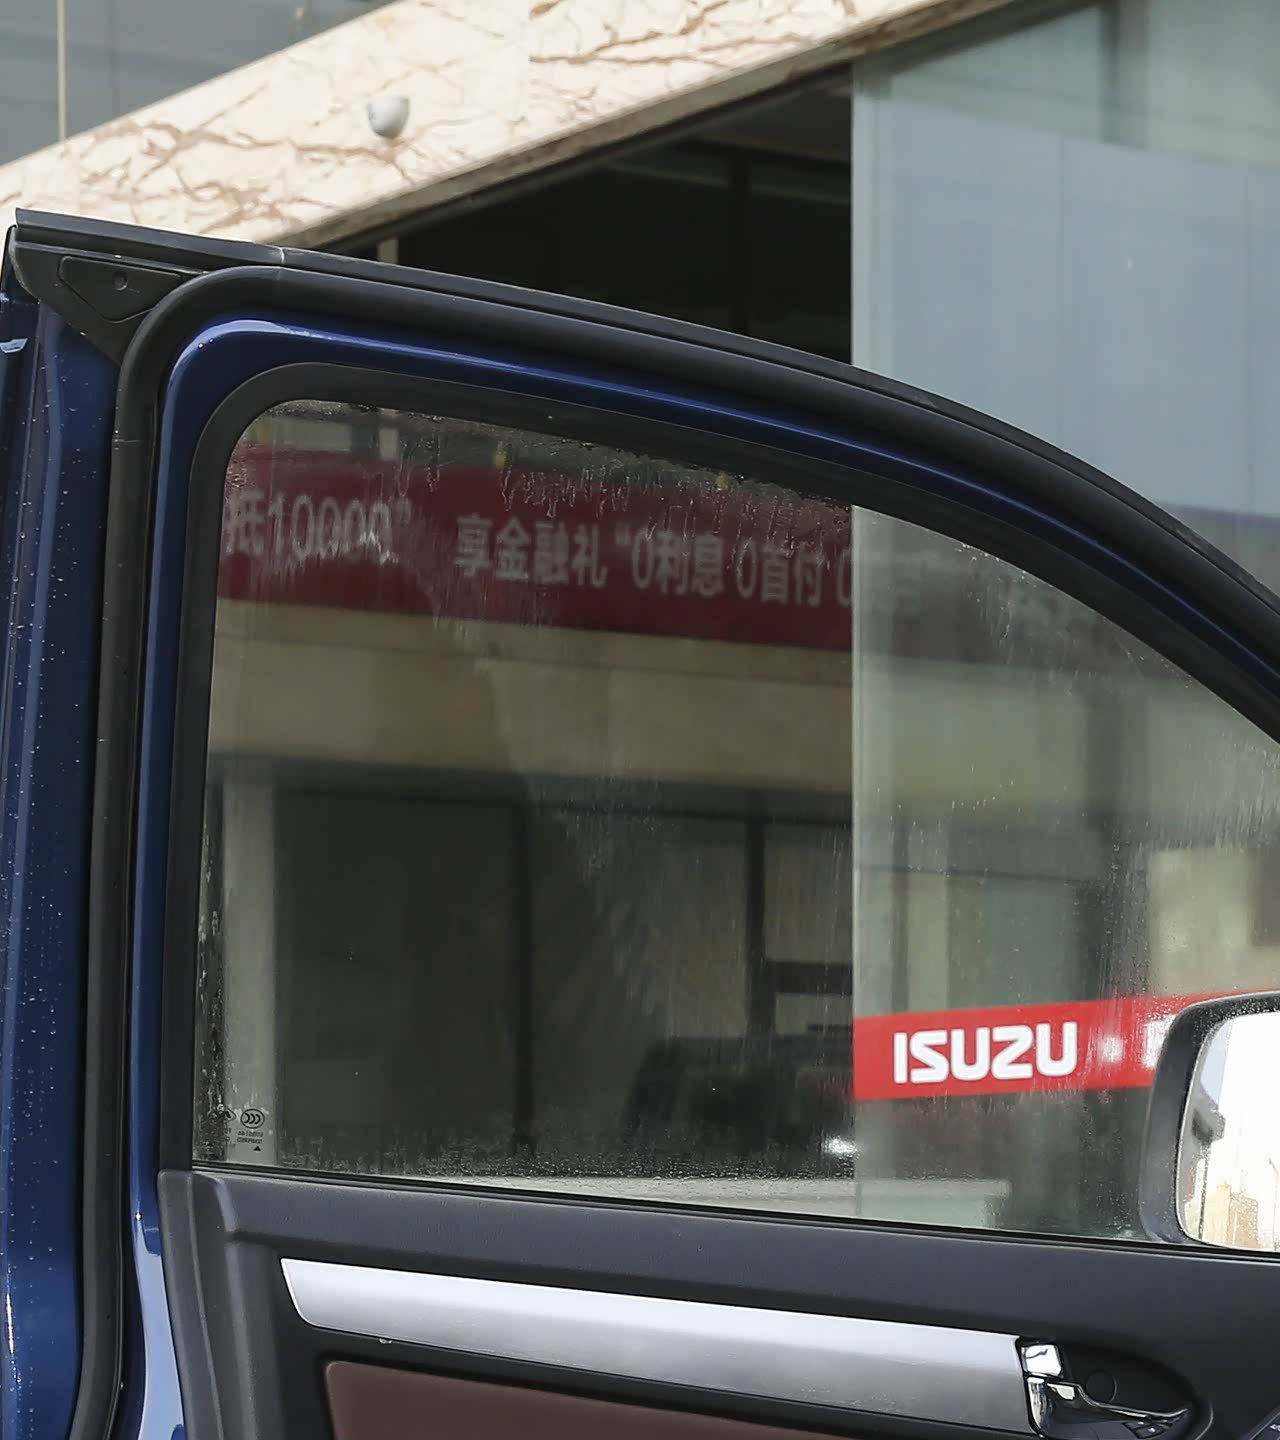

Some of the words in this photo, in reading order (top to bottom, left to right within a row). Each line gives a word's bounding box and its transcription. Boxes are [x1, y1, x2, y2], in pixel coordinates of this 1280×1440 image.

[455, 515, 608, 588] 享金融礼
[893, 1021, 1078, 1084] ISUZU
